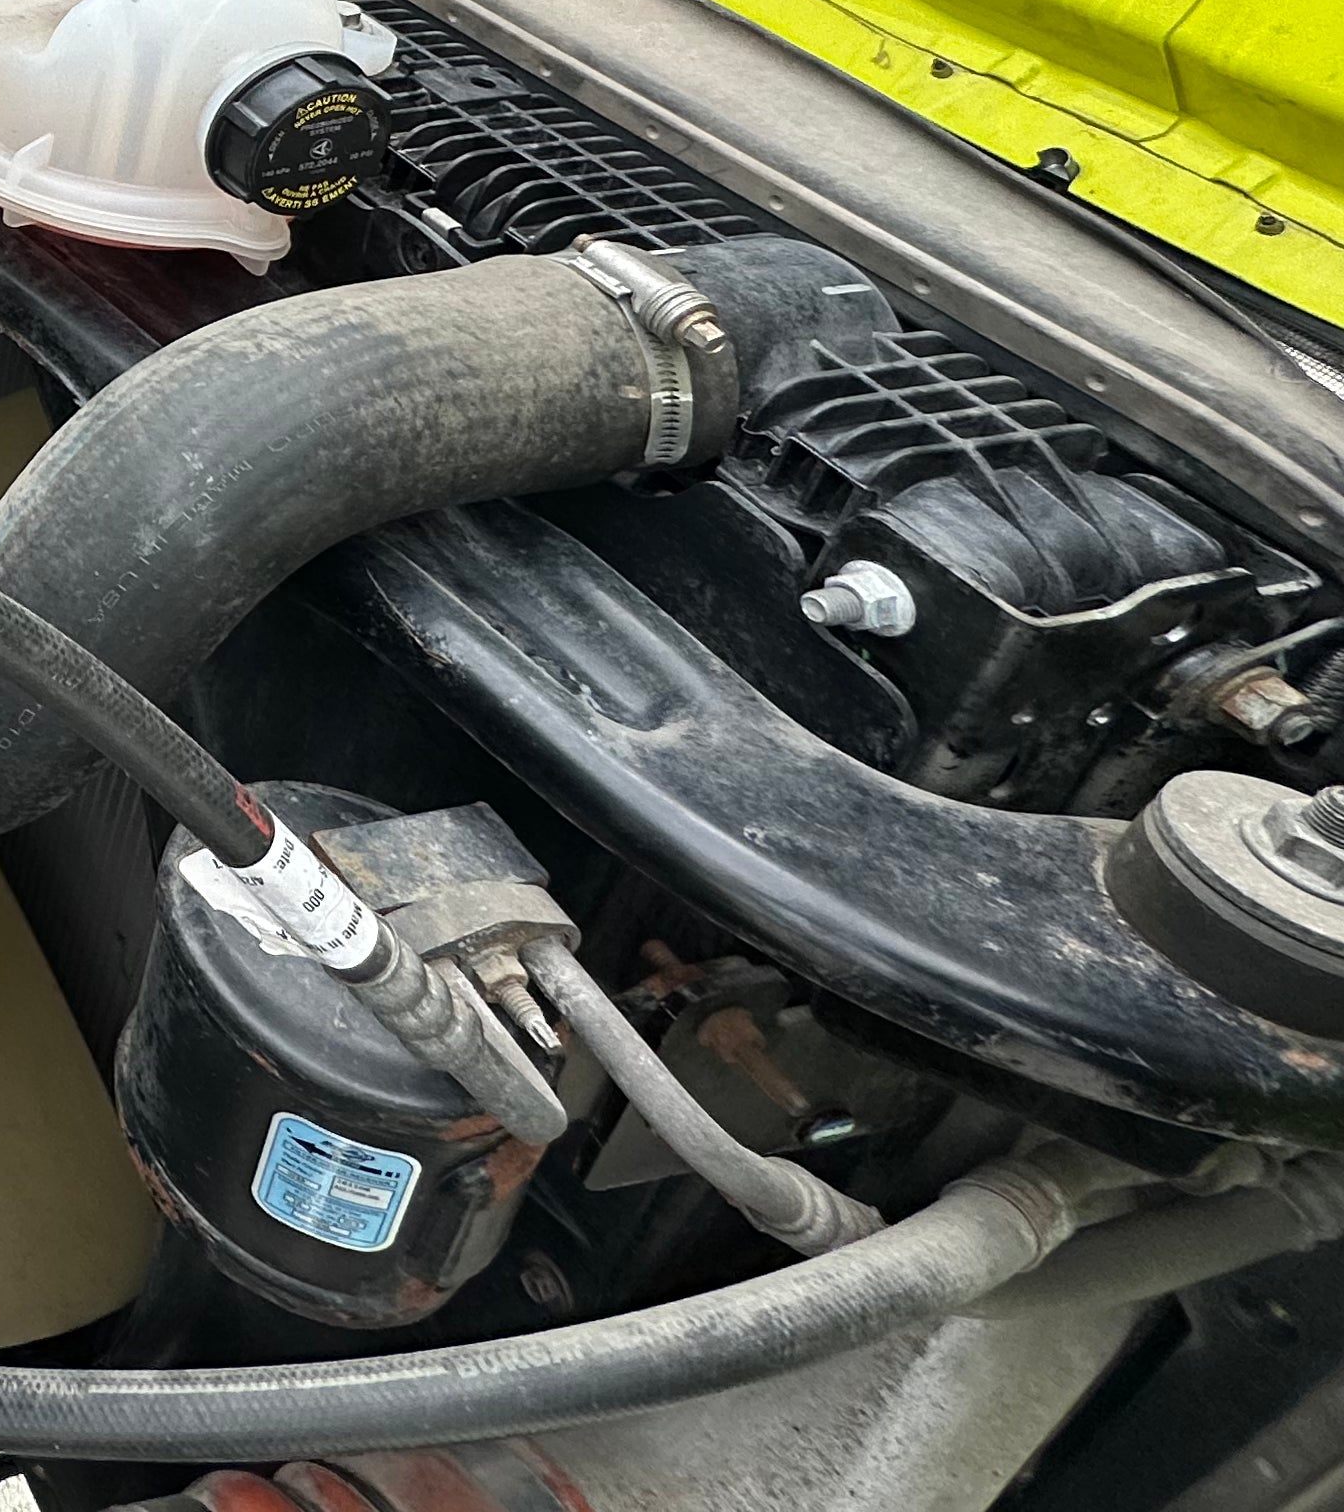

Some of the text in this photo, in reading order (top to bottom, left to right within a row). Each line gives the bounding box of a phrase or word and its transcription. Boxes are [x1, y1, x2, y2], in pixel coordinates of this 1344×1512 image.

[307, 93, 357, 111] CAUTION
[294, 104, 364, 129] NEVER OPEN HOT
[273, 837, 295, 874] Date:
[341, 901, 363, 941] Made
[327, 937, 346, 952] in
